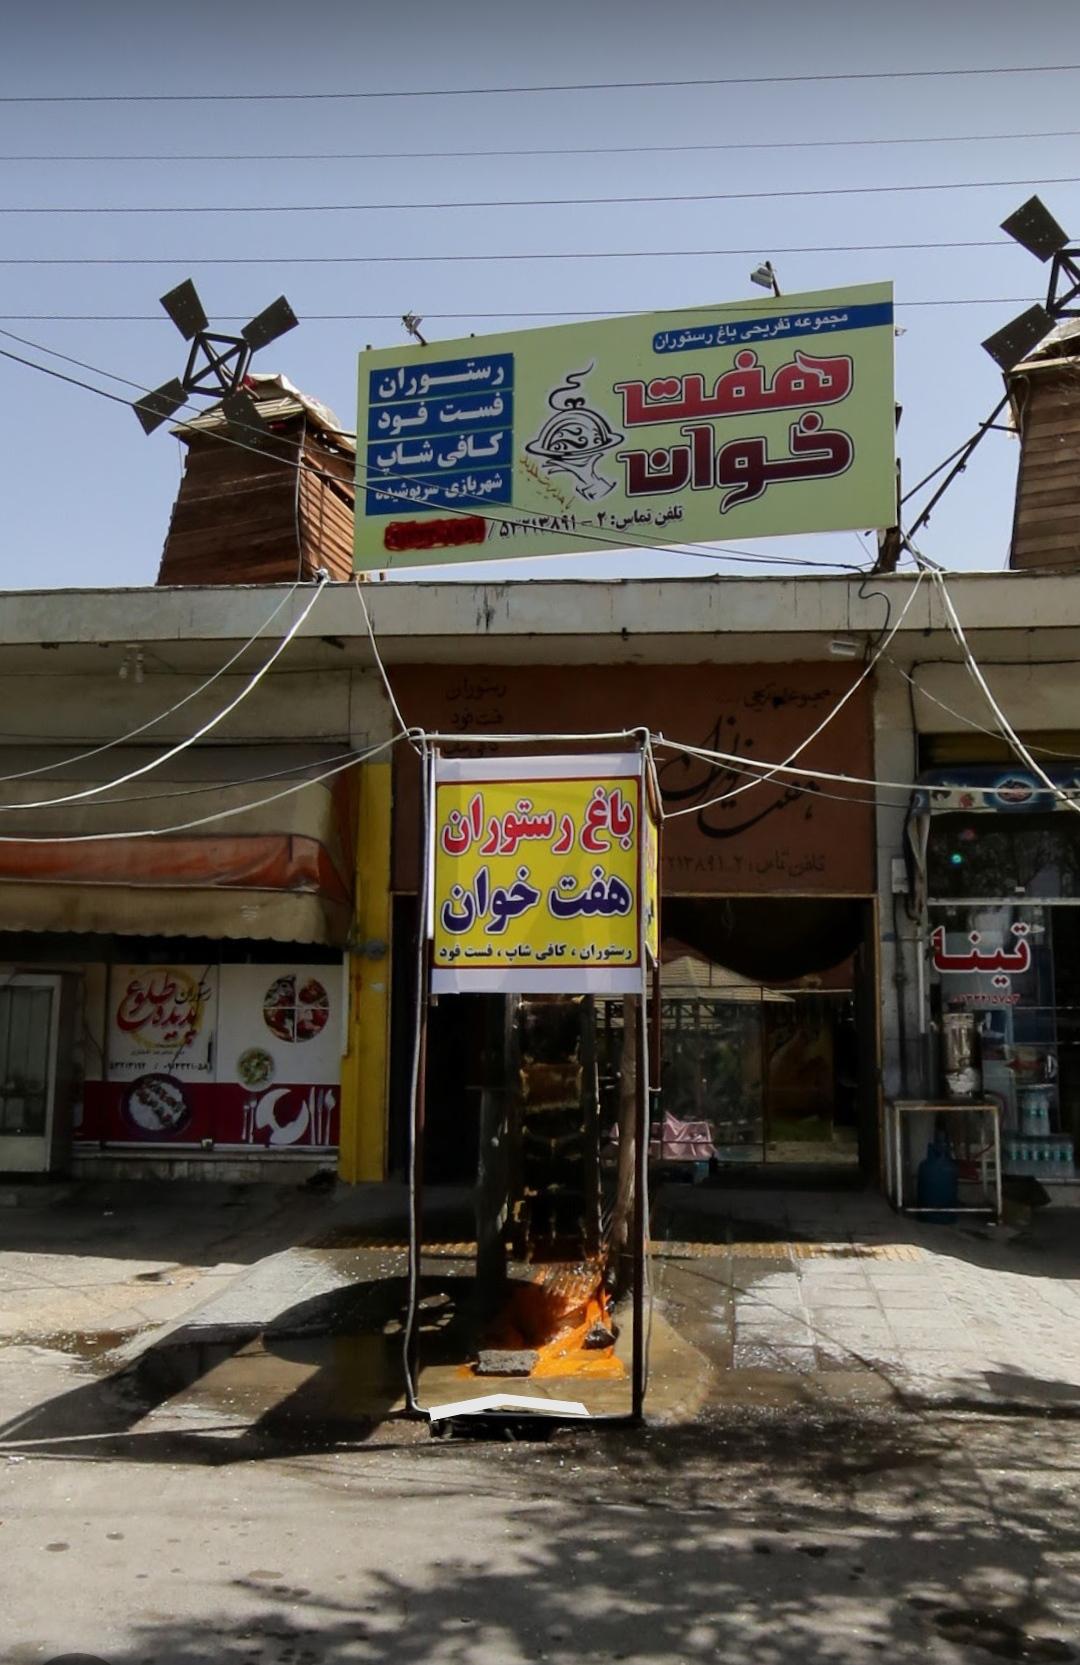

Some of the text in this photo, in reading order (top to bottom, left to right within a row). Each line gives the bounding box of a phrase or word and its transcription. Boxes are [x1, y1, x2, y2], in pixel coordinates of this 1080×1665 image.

[654, 313, 849, 351] مجموعه تفریحی باغ رستوران
[378, 362, 505, 398] رستوران
[613, 348, 854, 430] هفت
[377, 391, 504, 435] فست فود
[376, 431, 504, 475] کافی شاپ
[614, 410, 856, 516] خوان
[444, 472, 503, 498] شهربازی
[654, 505, 683, 526] تلفن
[442, 786, 634, 857] باغ رستوران
[441, 863, 541, 935] خوان
[549, 863, 634, 919] هفت
[439, 945, 460, 961] فود
[464, 944, 493, 958] فست
[505, 944, 531, 961] شاپ
[535, 944, 567, 960] کافی
[579, 942, 632, 960] رستوران
[930, 922, 1031, 988] تینا
